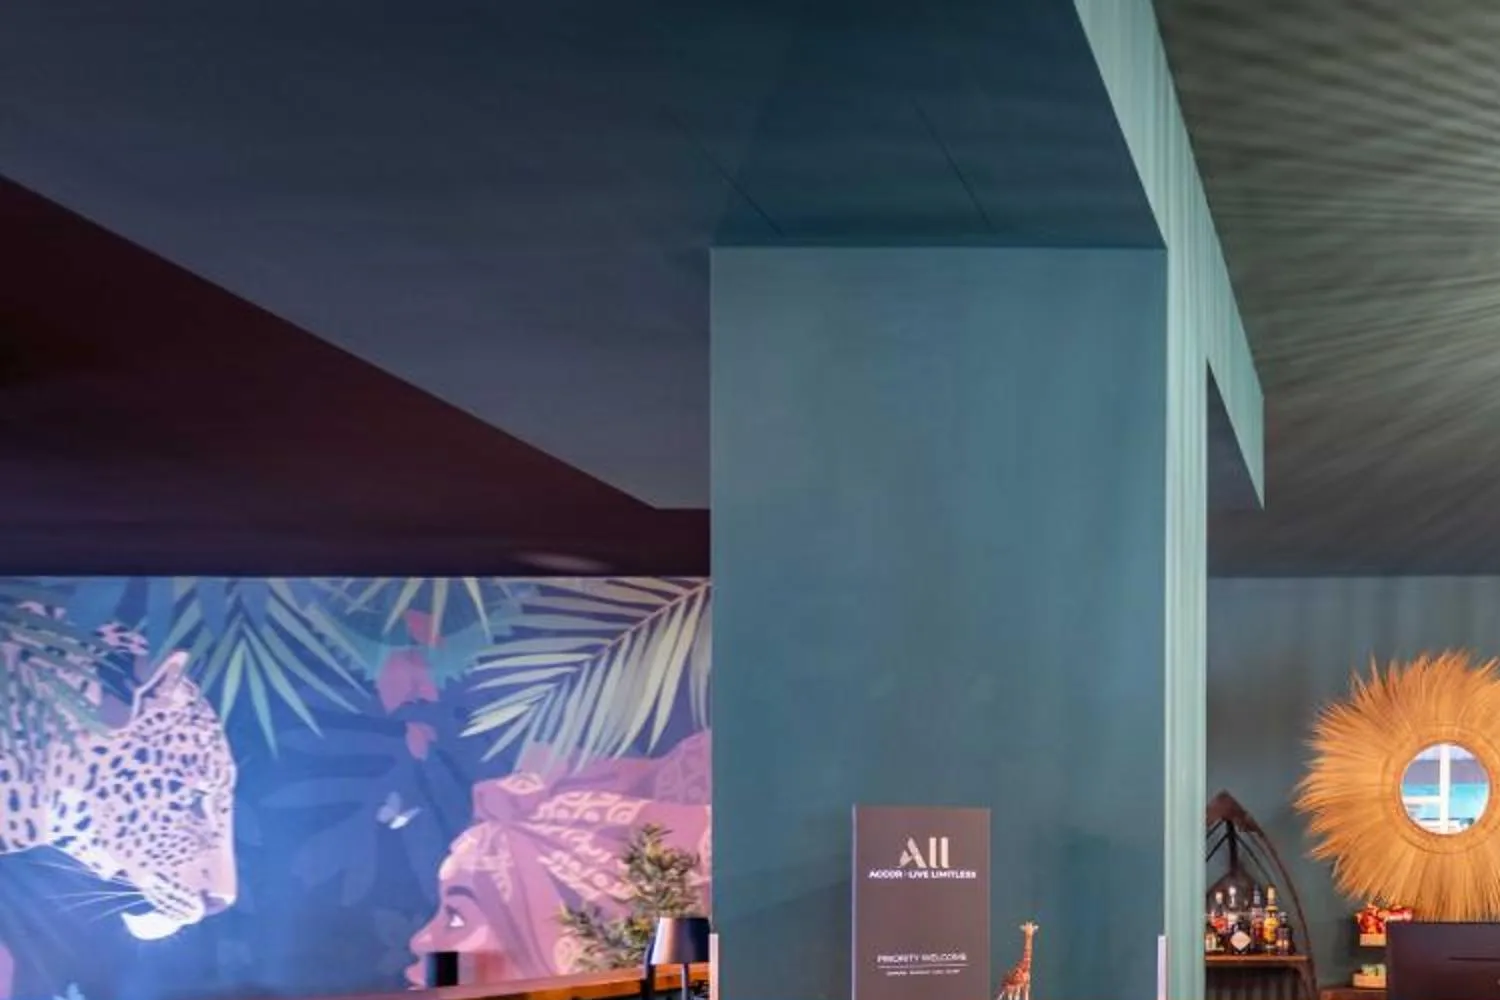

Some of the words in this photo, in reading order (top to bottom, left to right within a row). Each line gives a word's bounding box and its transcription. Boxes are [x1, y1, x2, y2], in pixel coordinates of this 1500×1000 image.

[868, 870, 903, 878] ACCOR
[908, 870, 929, 878] LIVE
[931, 870, 977, 878] LIMITLESS
[921, 953, 967, 961] WELCOME
